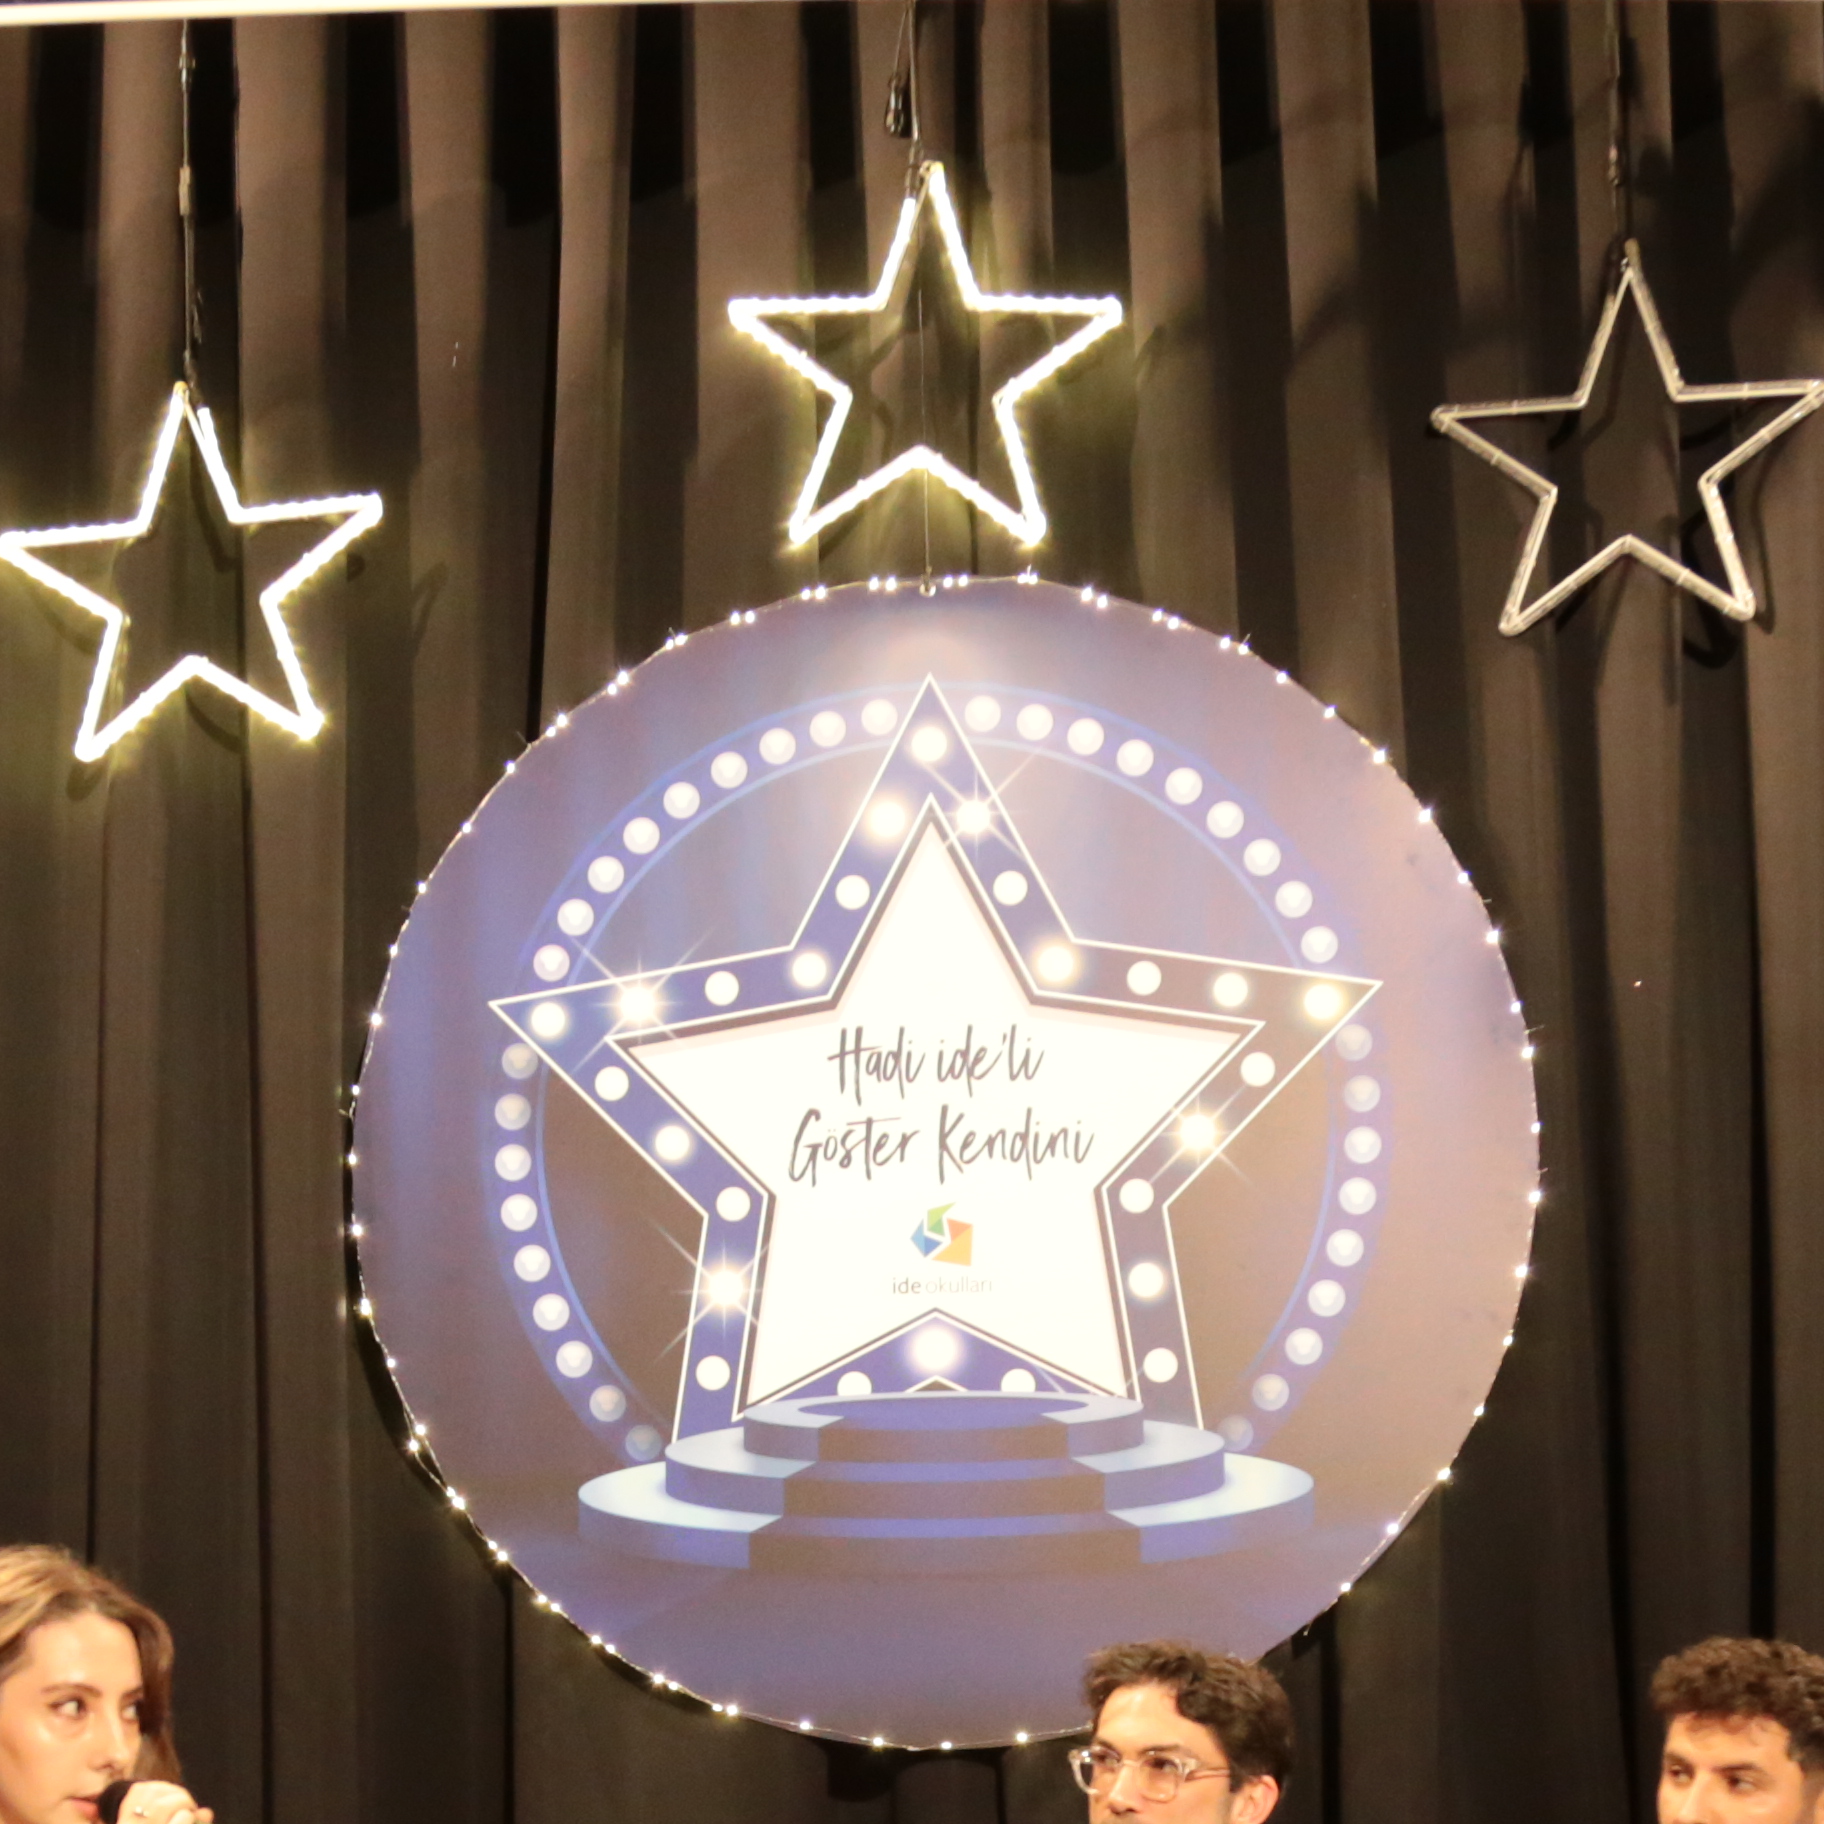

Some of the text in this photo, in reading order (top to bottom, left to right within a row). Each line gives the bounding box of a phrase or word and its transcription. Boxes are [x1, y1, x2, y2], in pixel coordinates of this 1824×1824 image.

[826, 1025, 926, 1107] Hadi
[788, 1103, 1095, 1188] Göster Kendini
[892, 1275, 993, 1295] ide okulları
